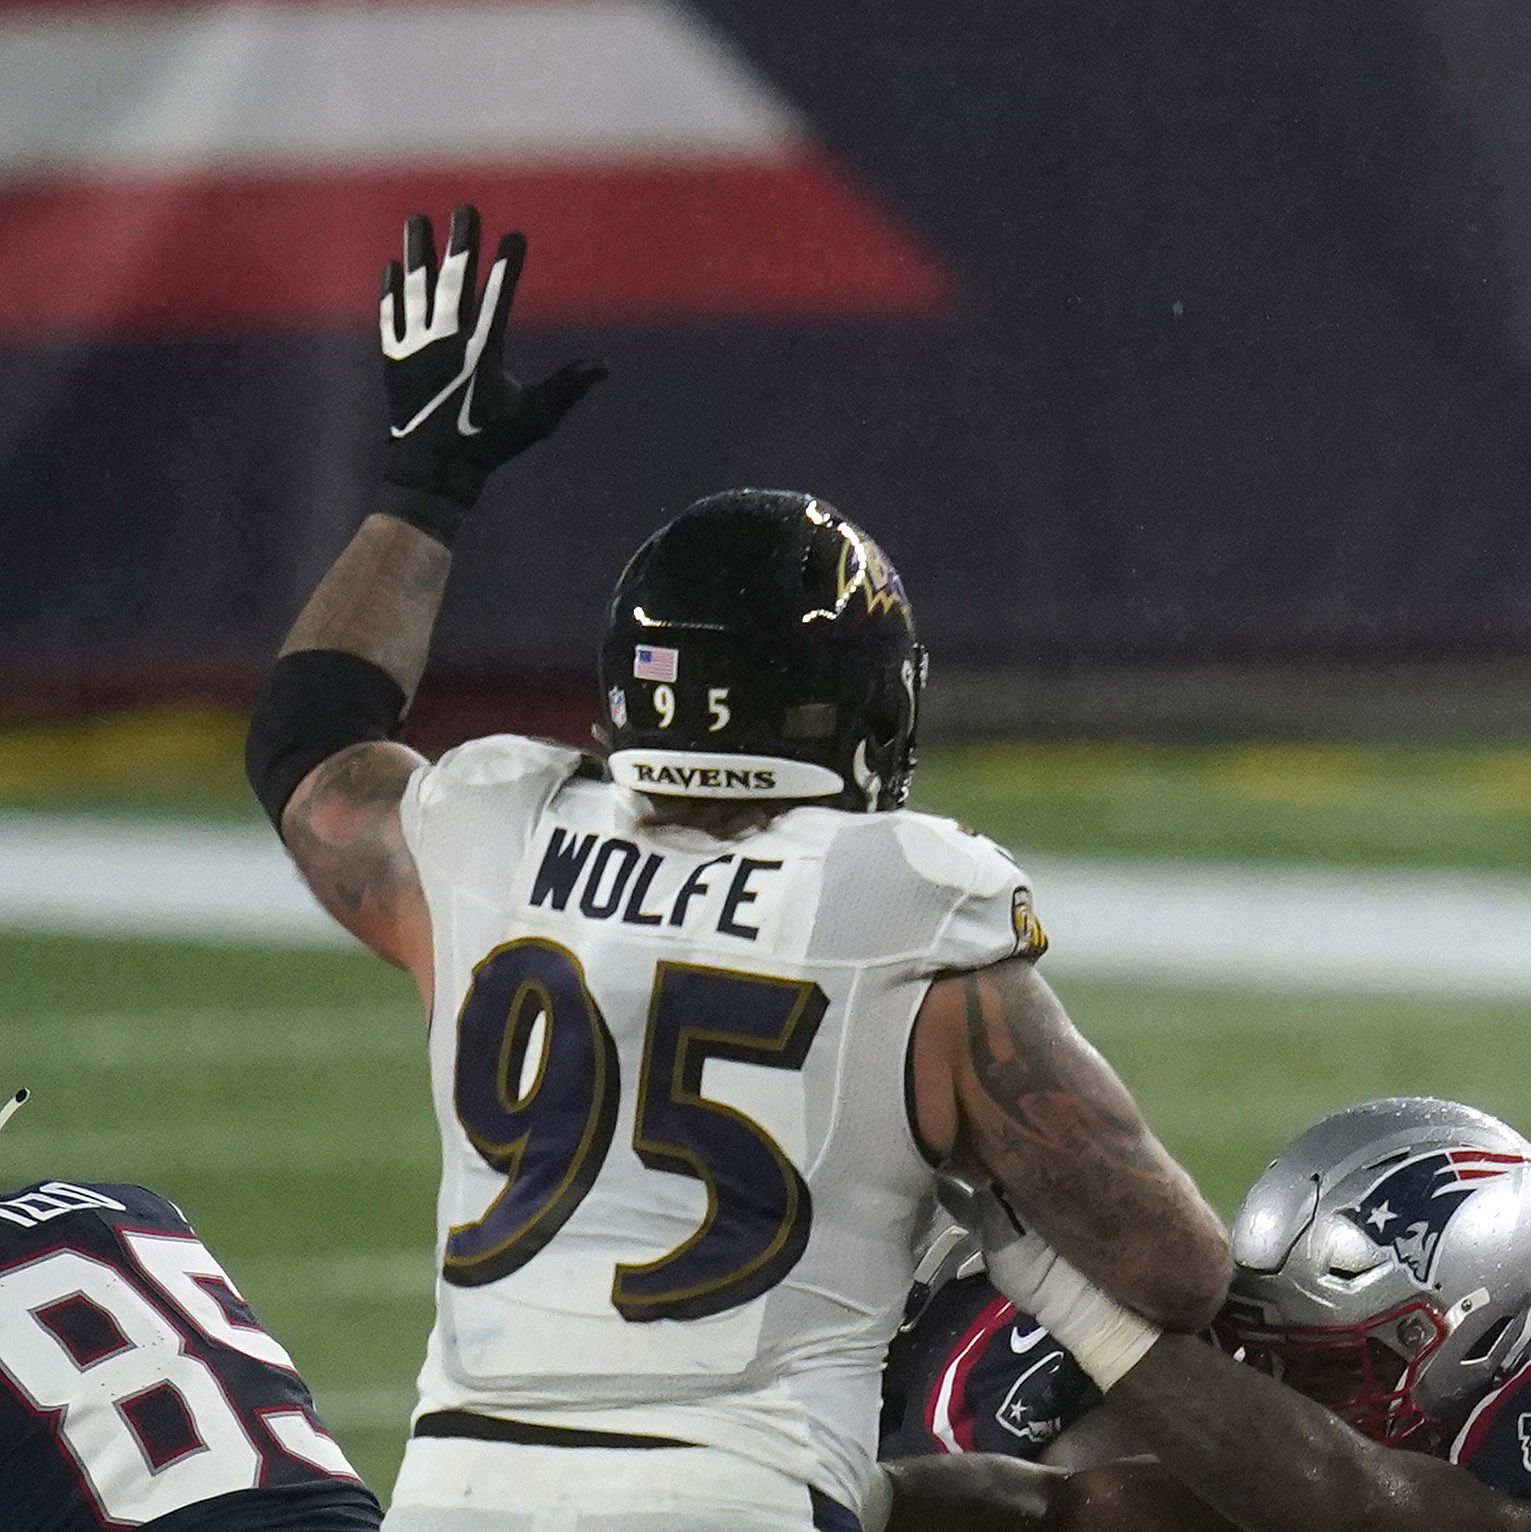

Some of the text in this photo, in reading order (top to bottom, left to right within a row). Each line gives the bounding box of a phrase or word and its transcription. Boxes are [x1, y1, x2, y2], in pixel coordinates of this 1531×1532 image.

[634, 763, 777, 790] RAVENS
[529, 827, 783, 941] WOLFE
[443, 936, 830, 1322] 95
[0, 1224, 362, 1530] 85
